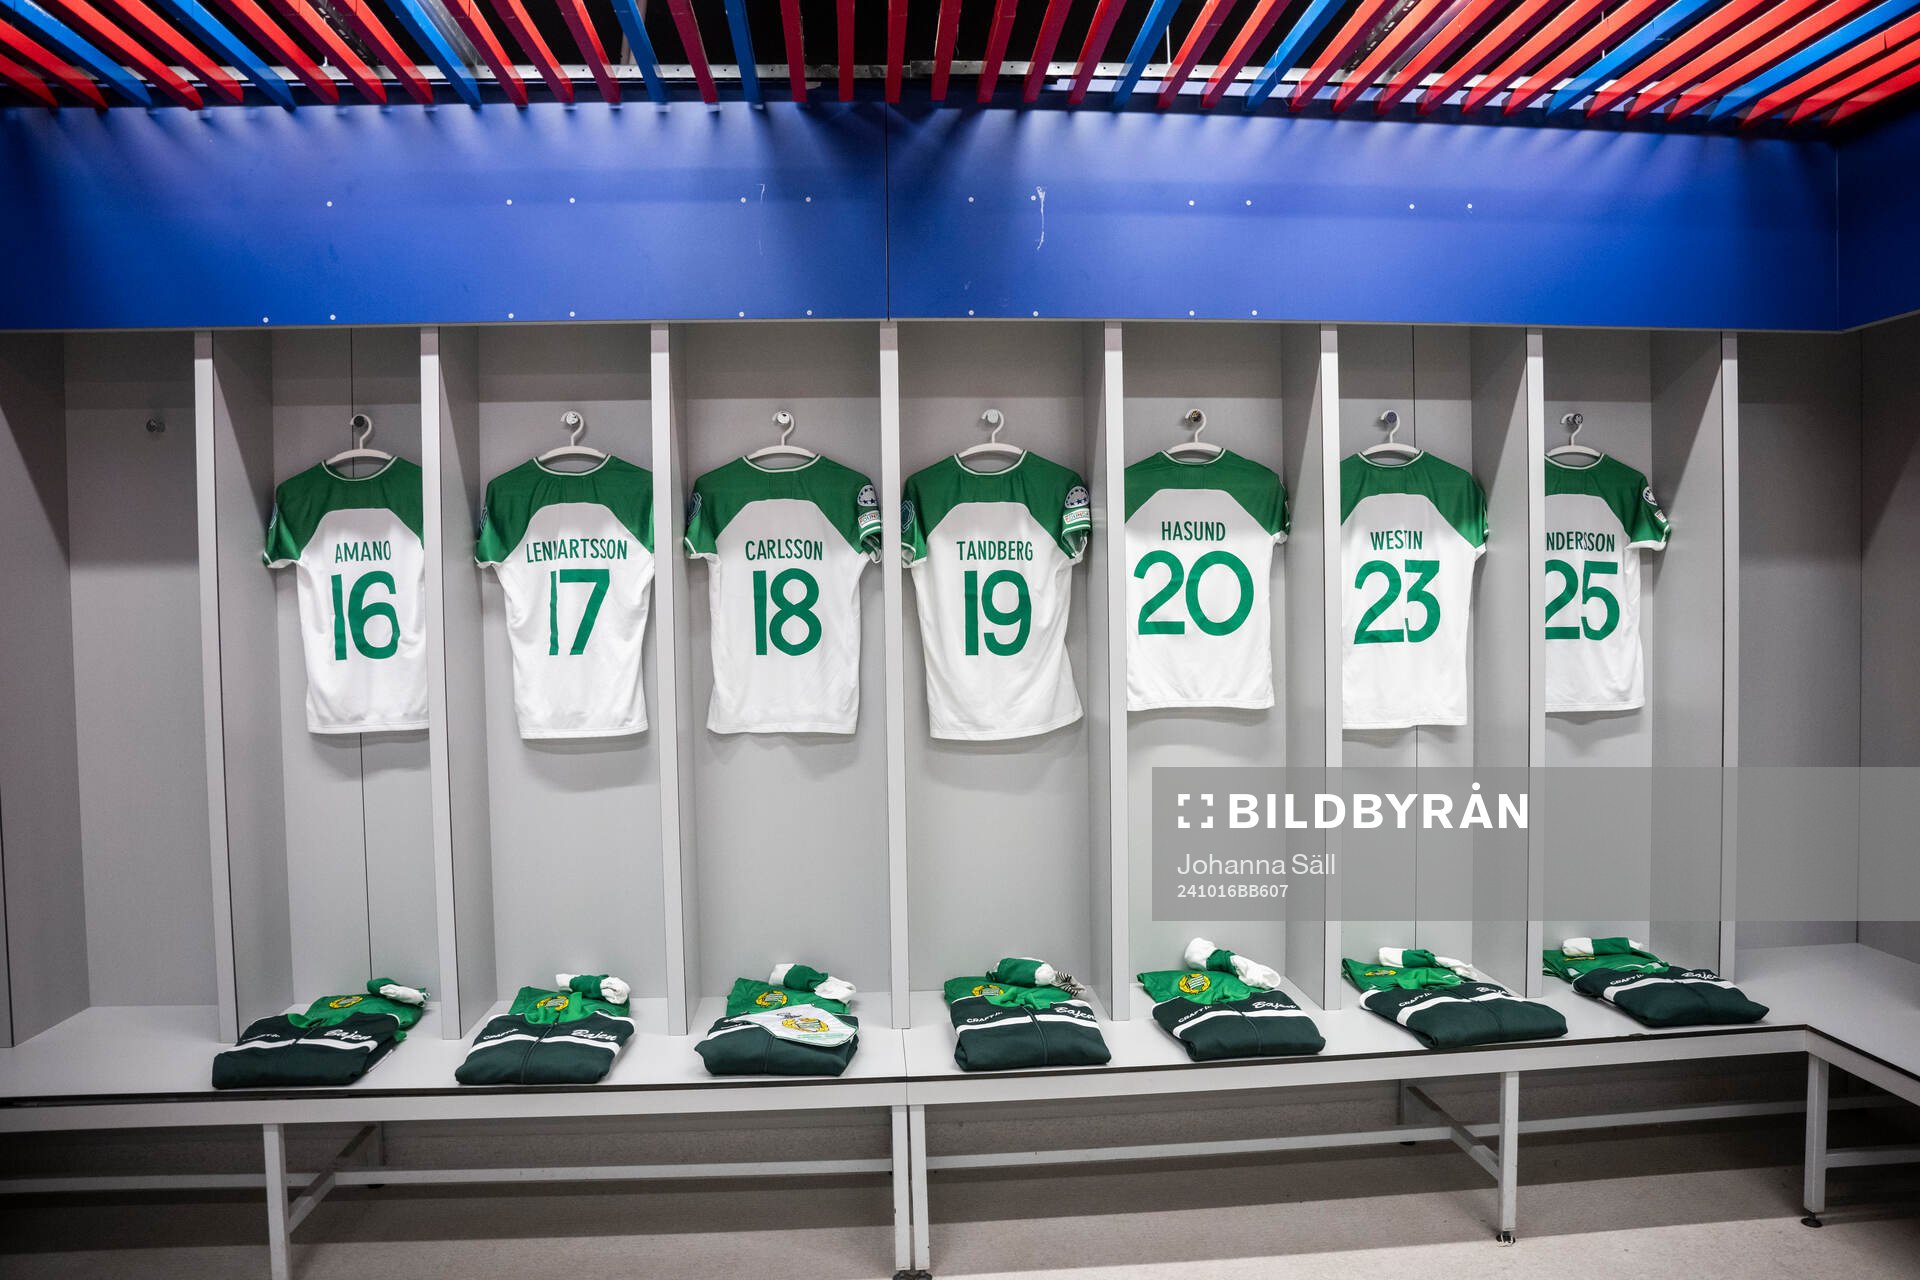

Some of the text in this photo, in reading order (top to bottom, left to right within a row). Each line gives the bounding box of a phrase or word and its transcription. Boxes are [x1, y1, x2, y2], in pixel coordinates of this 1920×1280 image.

[335, 540, 391, 563] AMANO
[745, 538, 823, 561] CARLSSON
[957, 540, 1034, 561] TANDBERG
[1161, 521, 1227, 541] HASUND
[1546, 531, 1615, 552] NDERSSON
[331, 570, 401, 661] 16
[548, 568, 611, 656] 17
[752, 568, 823, 656] 18
[963, 569, 1032, 657] 19
[1133, 550, 1254, 637] 20
[1353, 559, 1441, 645] 23
[1545, 559, 1620, 641] 25
